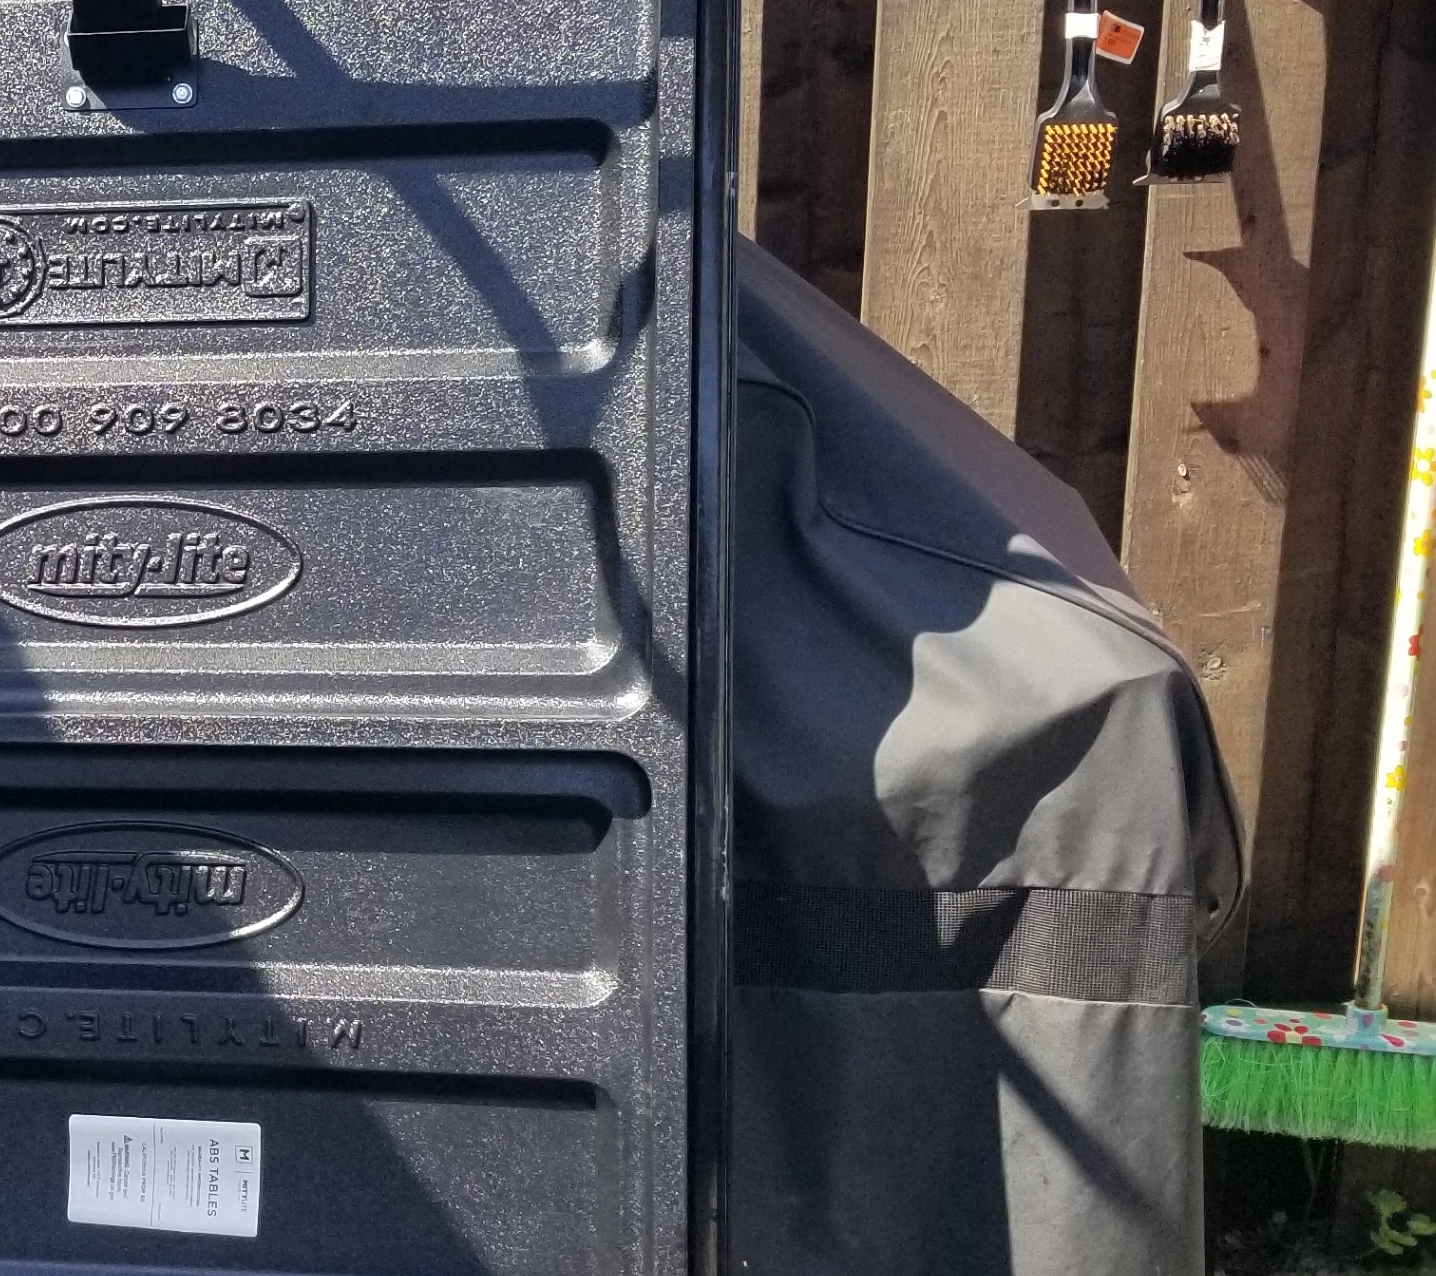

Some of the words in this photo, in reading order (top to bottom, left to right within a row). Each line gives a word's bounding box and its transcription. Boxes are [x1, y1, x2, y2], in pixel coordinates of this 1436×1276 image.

[47, 252, 241, 288] MITYLITE
[89, 401, 191, 437] 909
[215, 398, 357, 435] 8034
[209, 1138, 220, 1164] ABS
[206, 1166, 220, 1218] TABLES
